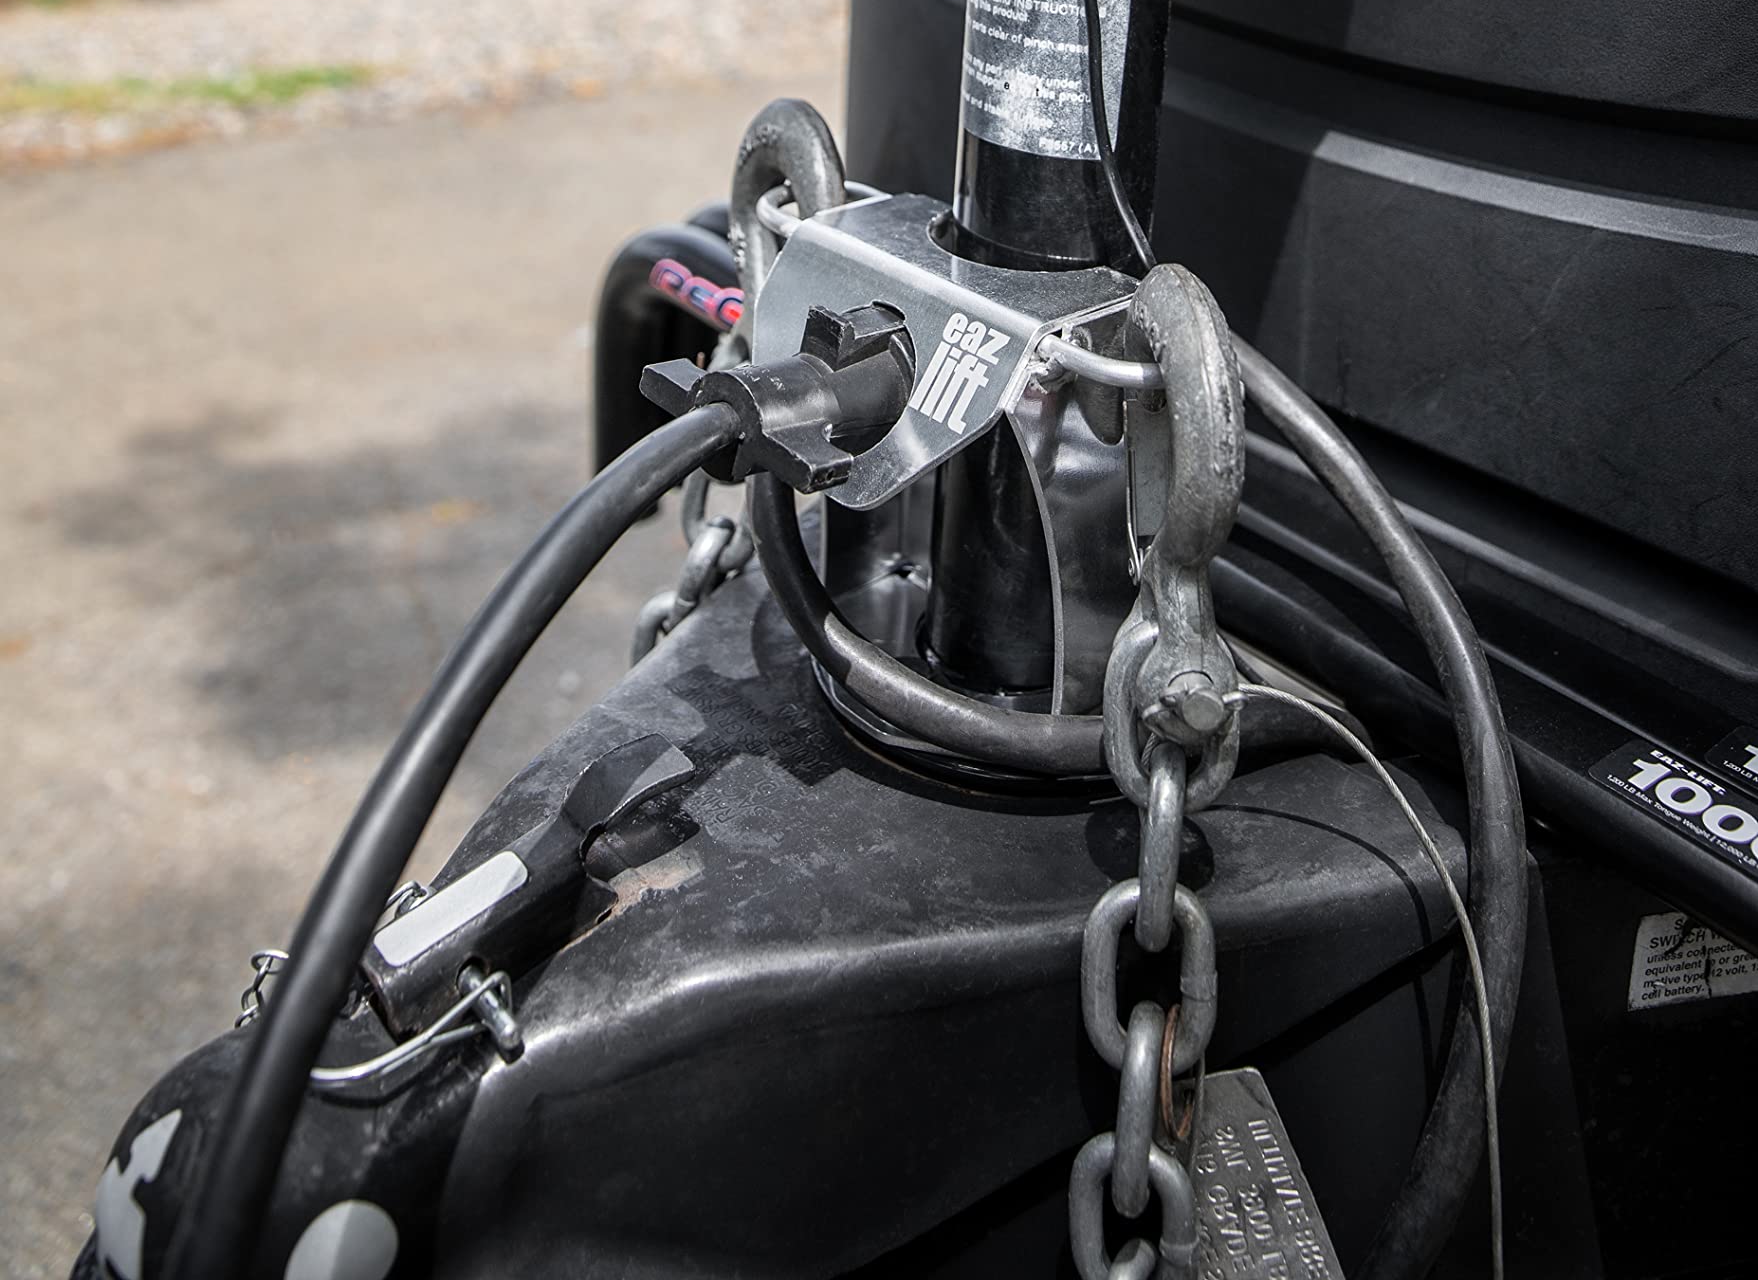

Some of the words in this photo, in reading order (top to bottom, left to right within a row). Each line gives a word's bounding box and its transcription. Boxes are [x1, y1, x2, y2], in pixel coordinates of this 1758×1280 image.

[1011, 34, 1022, 44] of
[1023, 36, 1055, 49] pinch
[1046, 78, 1082, 89] under
[1059, 91, 1092, 106] produ
[1078, 142, 1097, 154] (A)
[943, 313, 1010, 365] eaz
[909, 341, 989, 435] lift
[1623, 783, 1636, 794] LB
[1635, 791, 1654, 805] Max
[1653, 802, 1682, 822] Tongue
[1682, 818, 1711, 839] Weight
[1628, 758, 1758, 867] 100
[1645, 959, 1702, 976] equivalent
[1718, 955, 1729, 964] or
[1664, 984, 1704, 997] battery.
